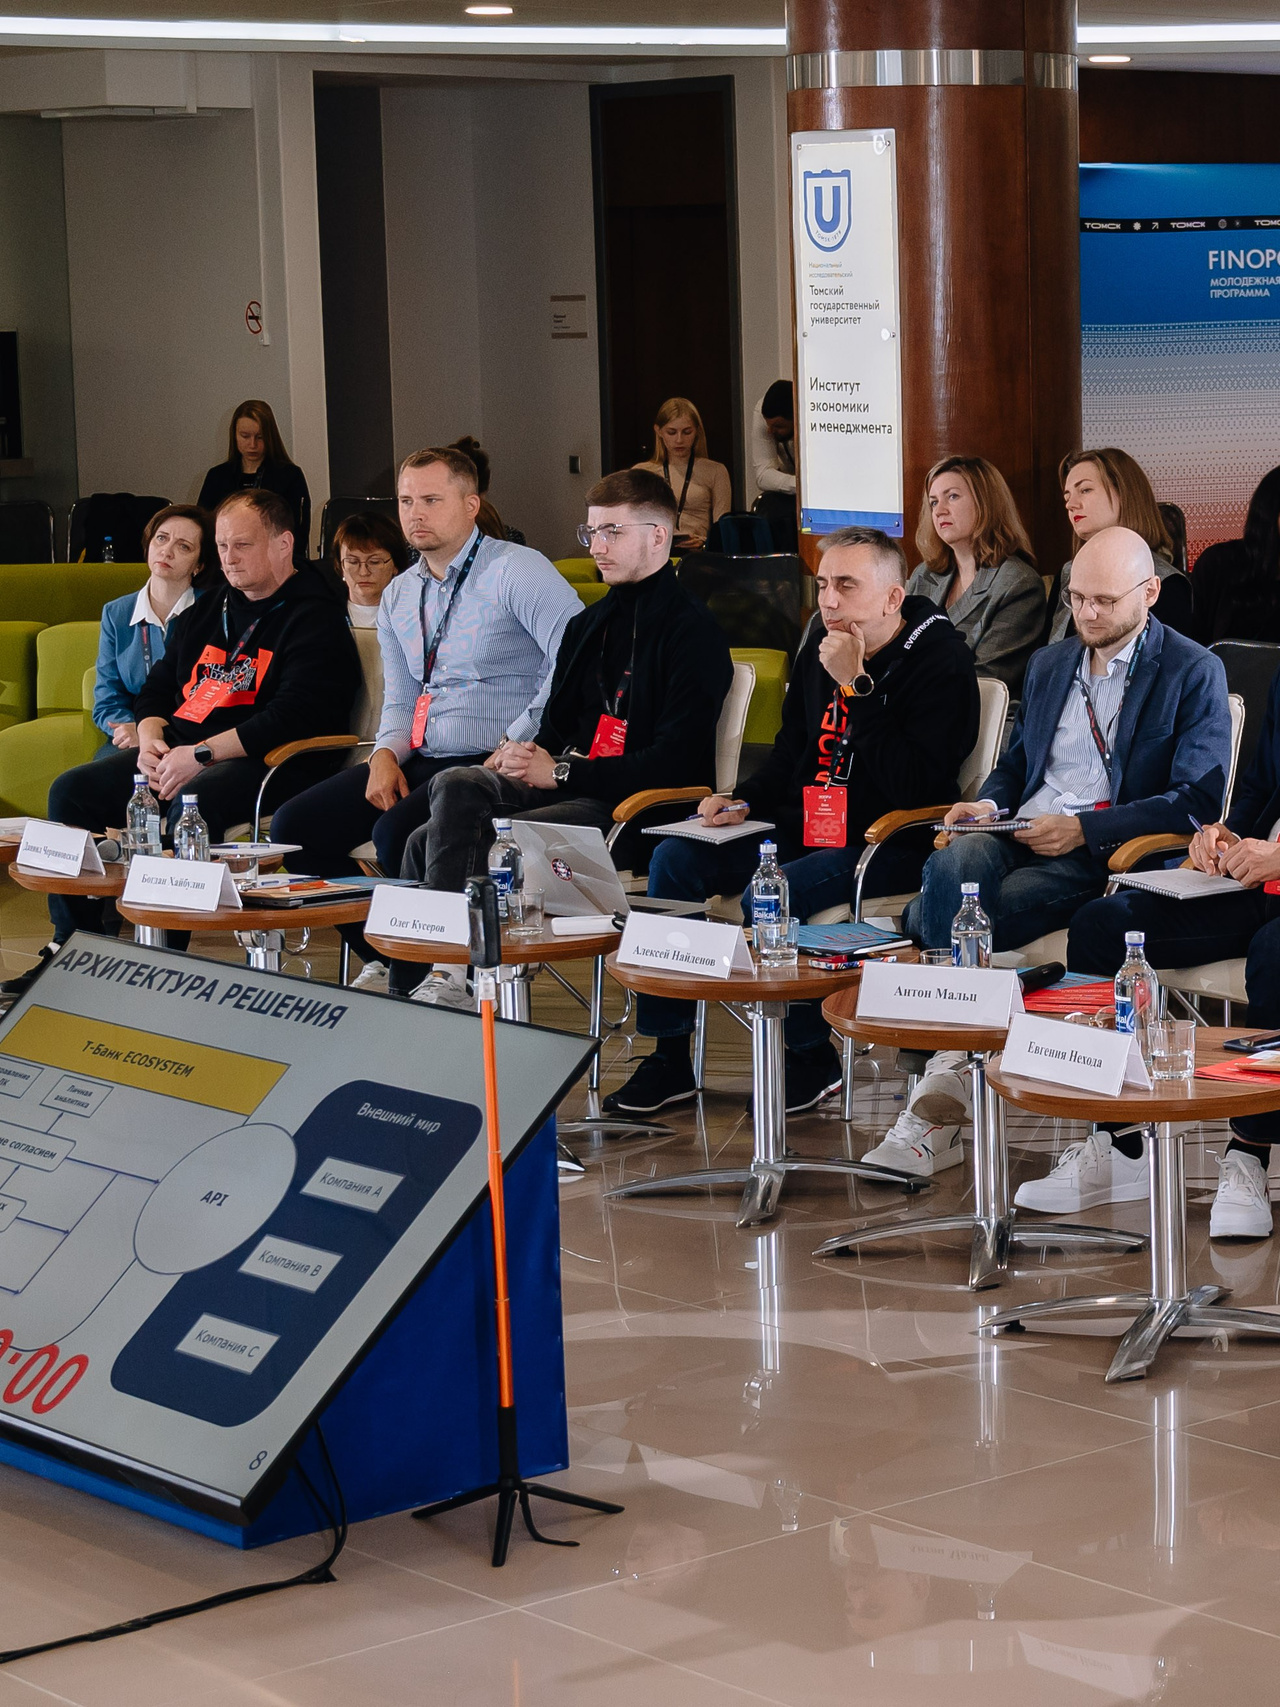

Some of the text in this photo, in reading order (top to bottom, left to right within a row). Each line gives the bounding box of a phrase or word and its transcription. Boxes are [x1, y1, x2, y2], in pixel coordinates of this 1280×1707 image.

[1084, 222, 1121, 230] ТОМСК
[1170, 221, 1206, 229] ТОМСК
[809, 284, 844, 297] Томский
[1210, 288, 1271, 299] ПРОГРАММА
[809, 299, 880, 313] государственный
[810, 314, 861, 327] университет
[809, 377, 860, 395] Институт
[809, 401, 869, 414] экономики
[810, 420, 893, 436] и менеджмента
[141, 872, 206, 890] Богдан Хайбулин
[389, 916, 446, 934] Олег Кусеров
[632, 945, 717, 968] Алексей Найденов
[54, 948, 349, 1029] АРХИТЕКТУРА РЕШЕНИЯ
[893, 984, 978, 1004] Антон Мальц
[81, 1040, 196, 1080] Т-Банк ECOSYSTEM
[1027, 1040, 1104, 1070] Евгения Нехода
[356, 1101, 442, 1135] Внешний мир
[9, 1140, 58, 1160] согласием
[319, 1172, 373, 1196] Компания
[200, 1190, 230, 1207] API
[257, 1249, 311, 1274] Компания
[194, 1329, 248, 1355] Компания
[248, 1450, 268, 1470] 8
